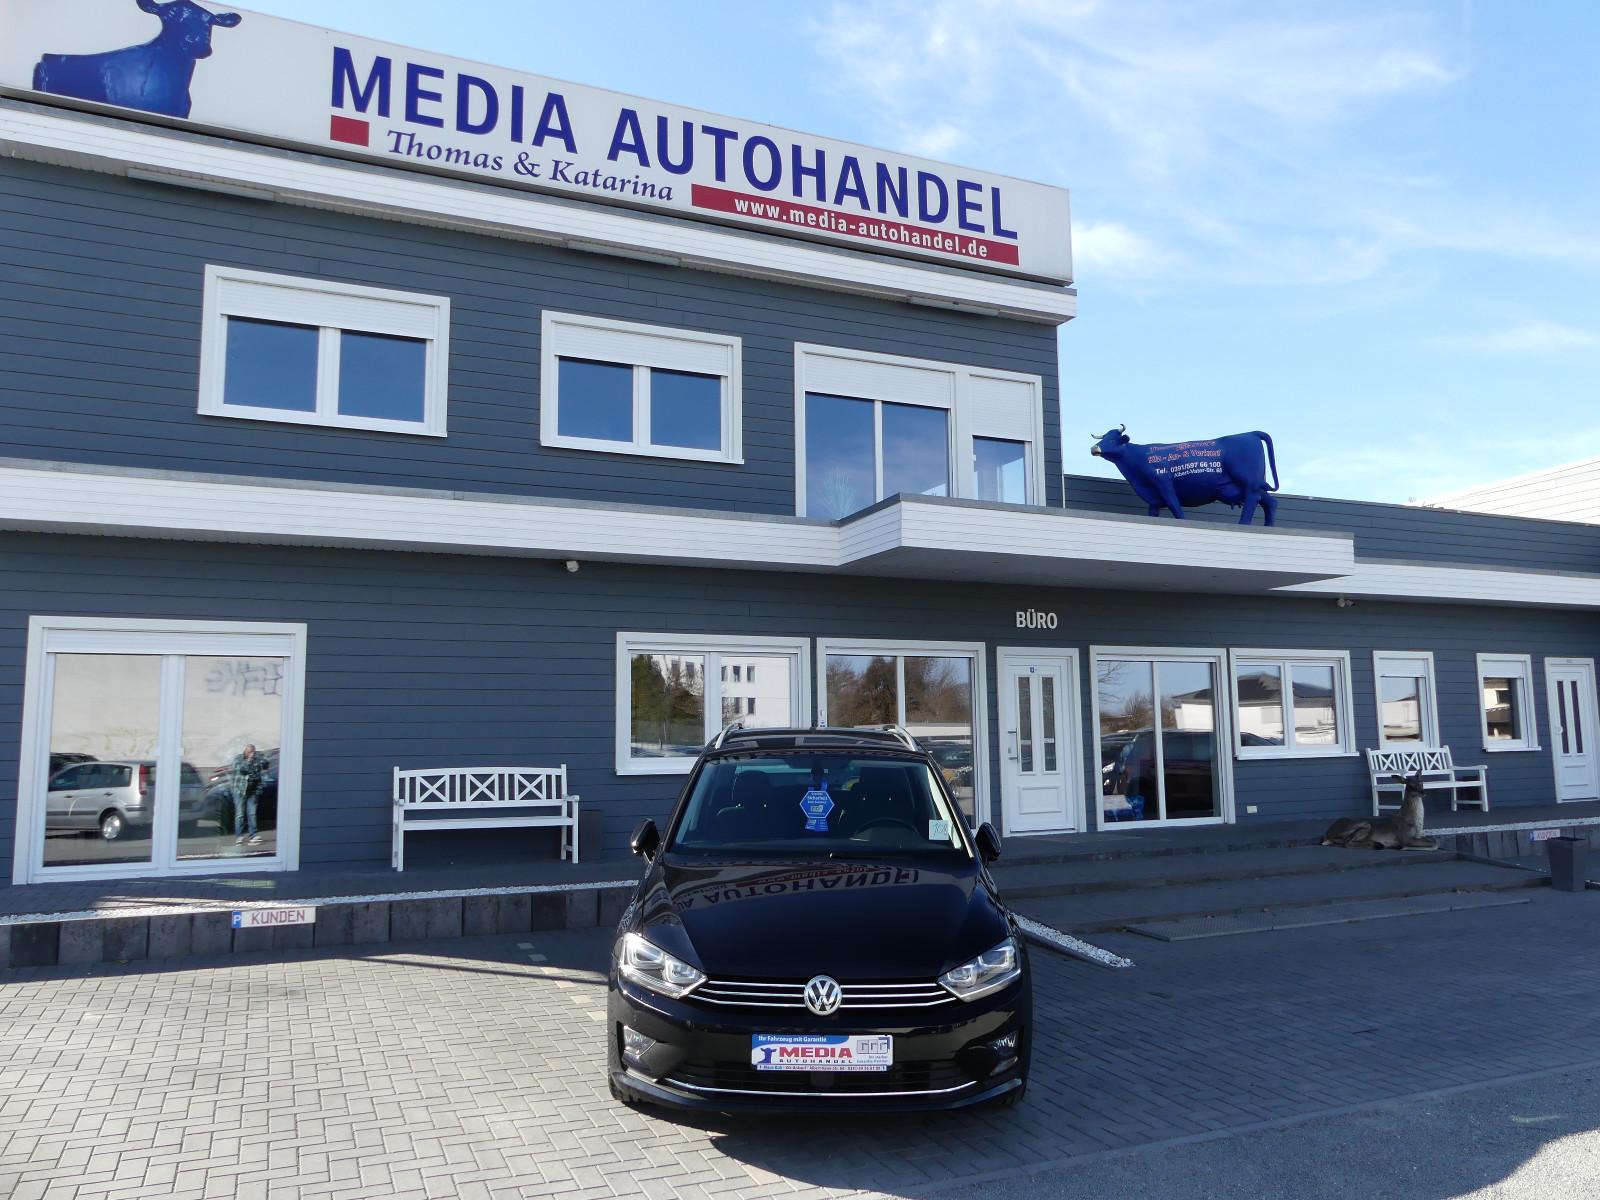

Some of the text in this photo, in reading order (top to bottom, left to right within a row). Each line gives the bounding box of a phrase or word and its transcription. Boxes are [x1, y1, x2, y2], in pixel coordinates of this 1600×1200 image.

[331, 46, 1018, 241] MEDIA AUTOHANDEL
[387, 130, 673, 201] Thomas & Katarina
[734, 199, 988, 258] www.media-autohandel.de
[1015, 608, 1058, 629] BÜRO
[251, 910, 305, 925] KUNDEN
[767, 1035, 792, 1043] Fahrzeug
[779, 1046, 853, 1058] MEDIA
